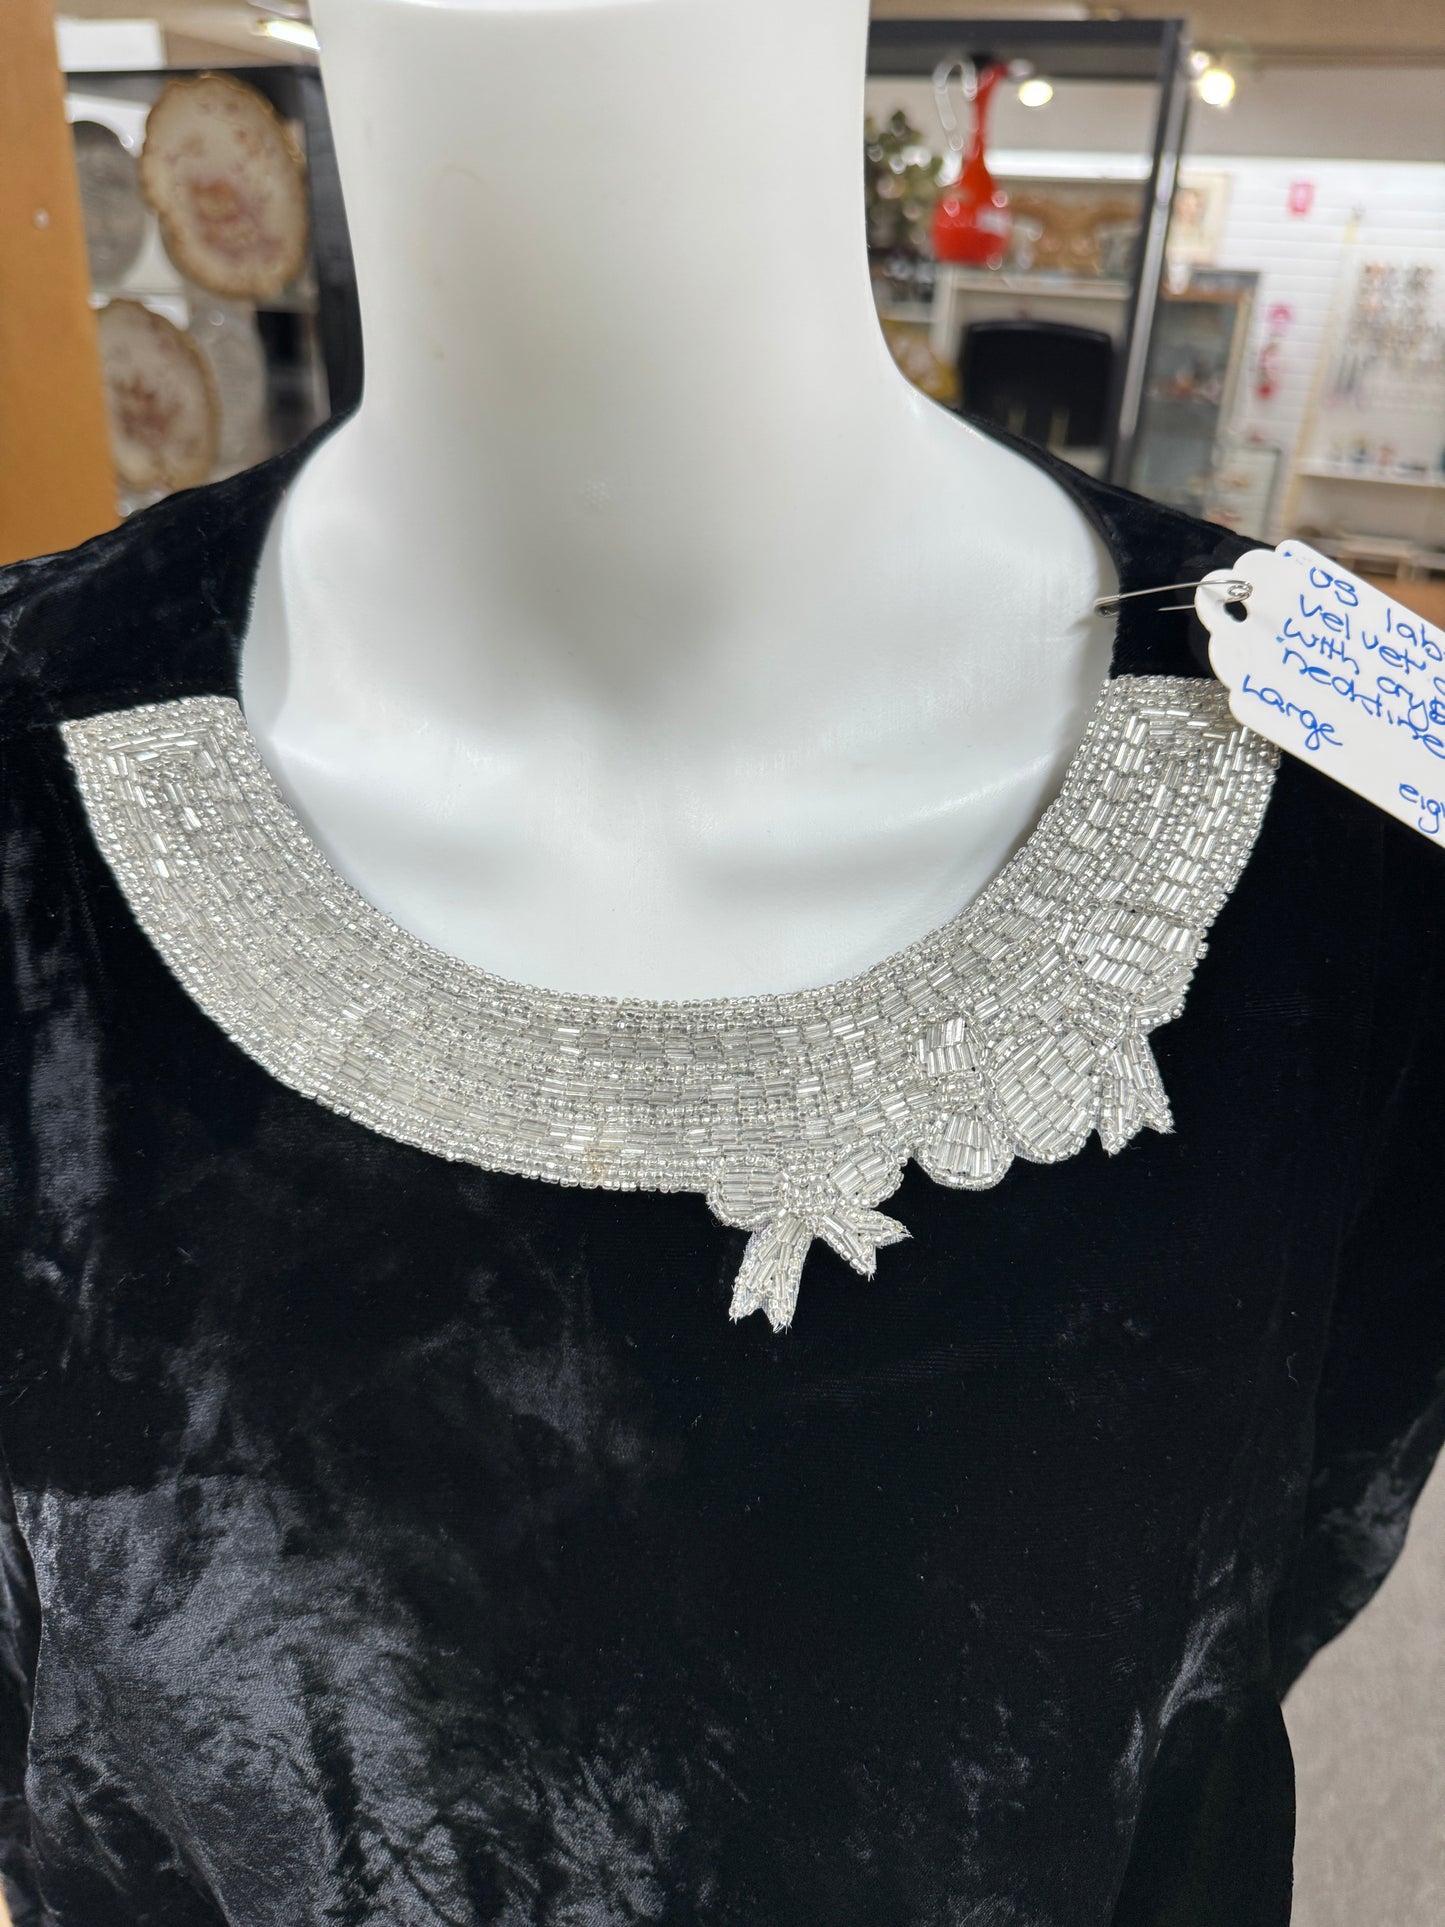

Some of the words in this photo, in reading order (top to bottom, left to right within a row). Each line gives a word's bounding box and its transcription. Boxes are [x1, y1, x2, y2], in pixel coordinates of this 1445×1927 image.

[1283, 617, 1360, 676] with
[1300, 594, 1427, 675] velvet
[1386, 608, 1445, 662] lab
[1242, 674, 1343, 751] Large
